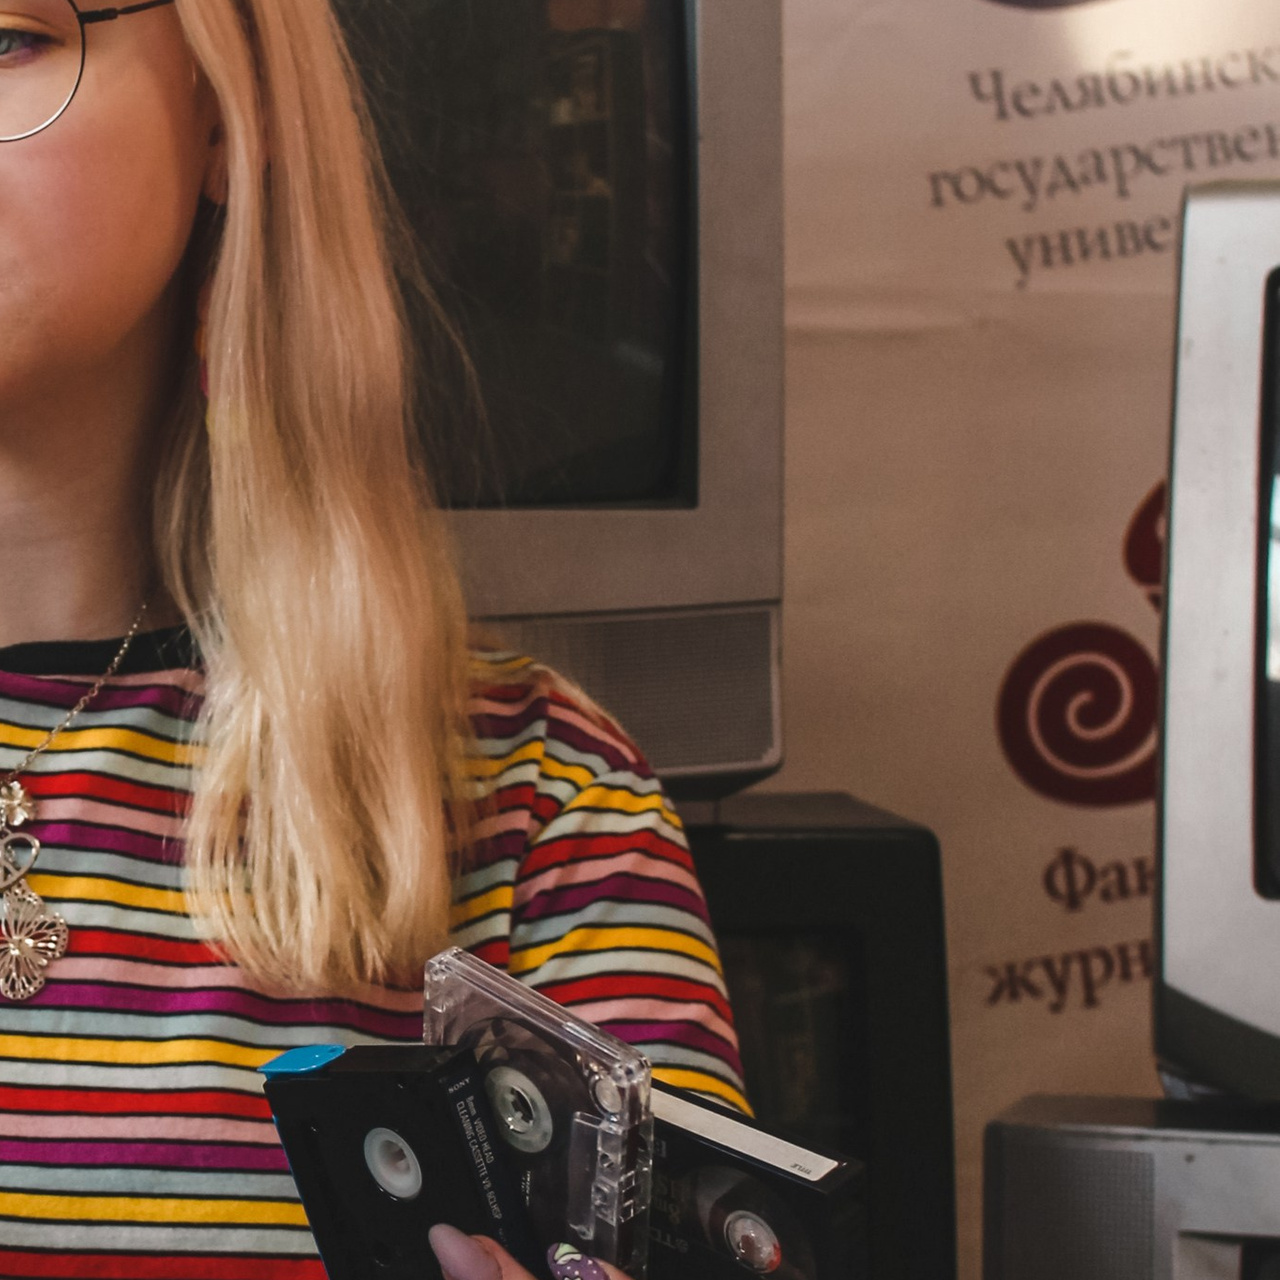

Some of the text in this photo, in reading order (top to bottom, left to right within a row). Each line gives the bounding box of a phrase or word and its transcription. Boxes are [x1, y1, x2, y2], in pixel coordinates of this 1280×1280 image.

[966, 46, 1280, 122] Челябинск
[926, 122, 1280, 212] государстве
[448, 1077, 471, 1094] SONY
[456, 1100, 476, 1140] CLEANING
[468, 1138, 489, 1178] CASSETTE
[474, 1117, 488, 1142] VIDEO
[481, 1141, 495, 1164] HEAD
